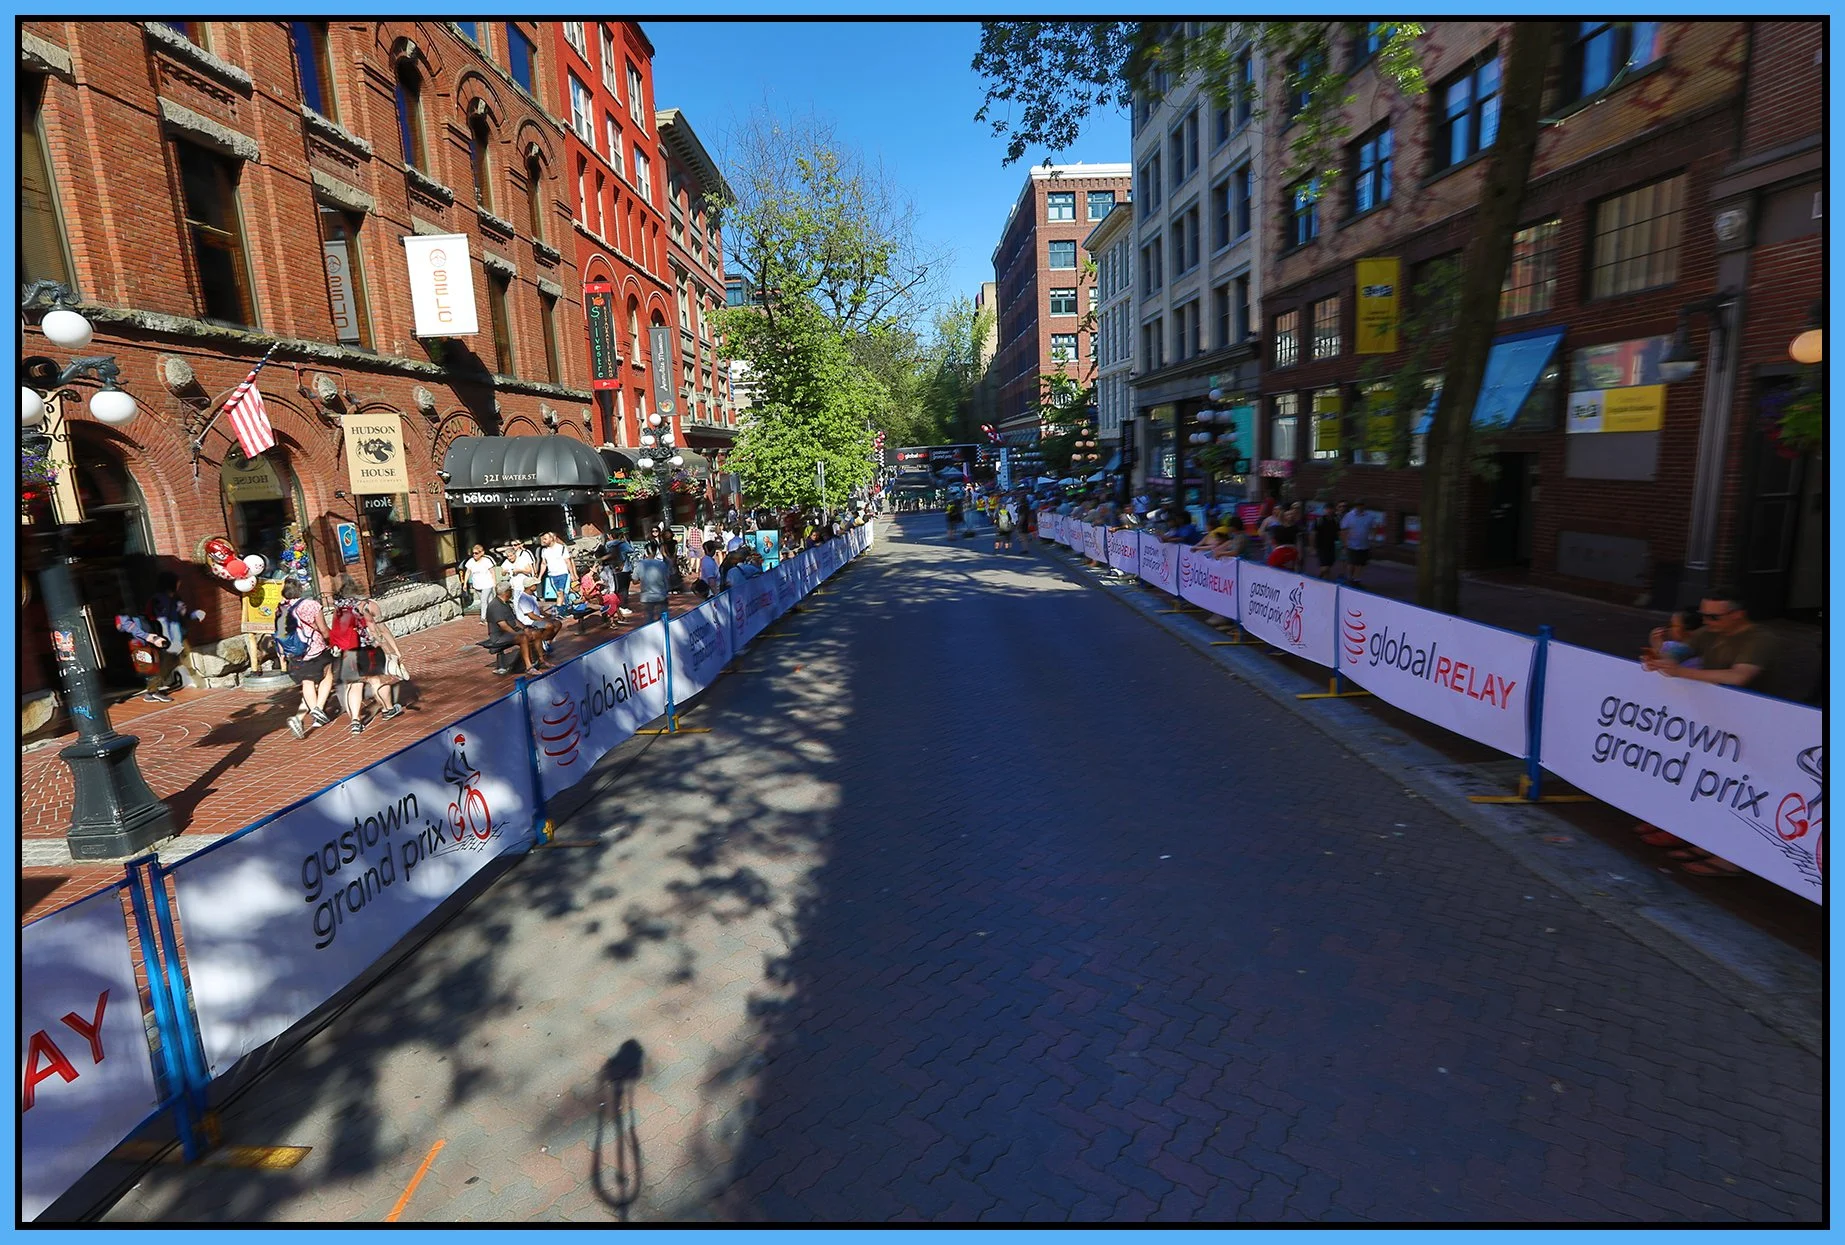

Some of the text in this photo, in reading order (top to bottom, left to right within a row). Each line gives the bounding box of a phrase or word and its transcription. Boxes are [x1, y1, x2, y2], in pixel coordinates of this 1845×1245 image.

[590, 305, 604, 378] Silvestre
[351, 425, 396, 435] HUDSON
[361, 468, 397, 478] HOUSE
[483, 474, 499, 485] 321
[502, 473, 527, 481] WATER
[1248, 600, 1284, 625] grand prix
[1250, 581, 1281, 600] gastown
[579, 654, 665, 739] globalRELA
[1597, 695, 1742, 763] gastown
[1591, 732, 1769, 818] grand prix
[302, 792, 419, 903] gastown
[313, 818, 446, 950] grand prix
